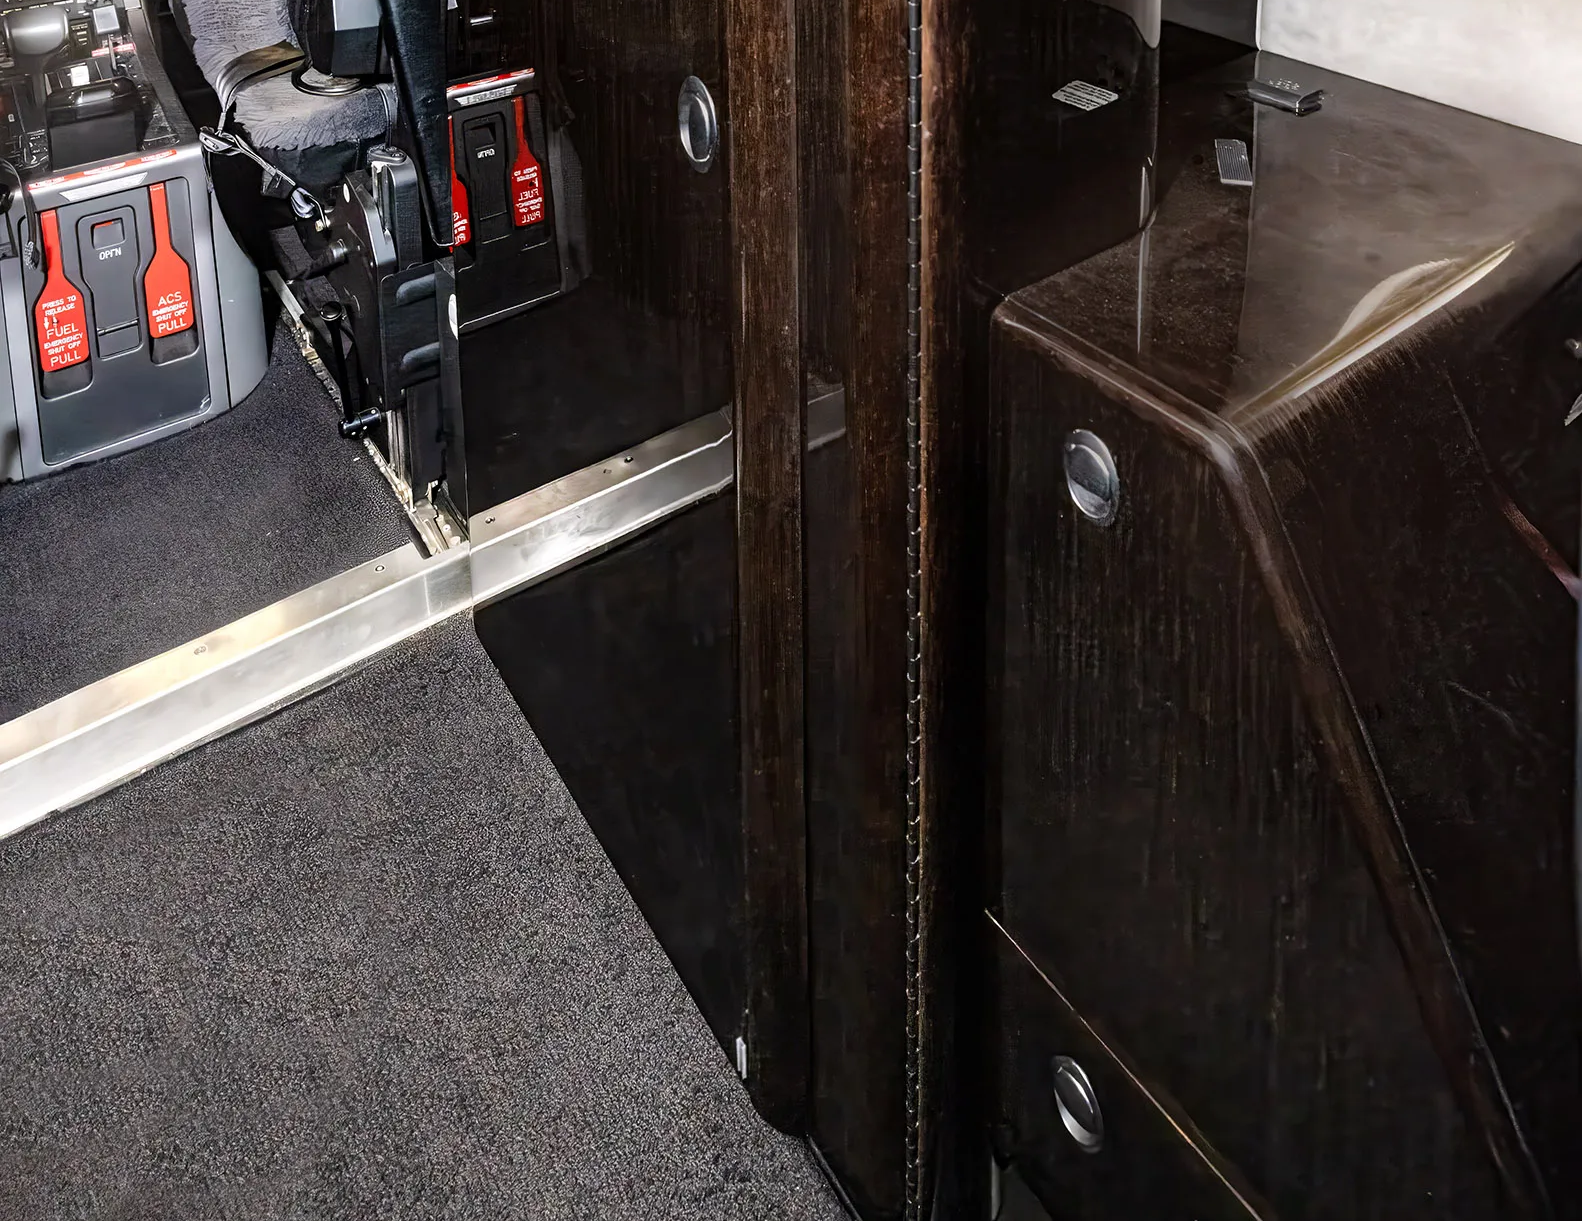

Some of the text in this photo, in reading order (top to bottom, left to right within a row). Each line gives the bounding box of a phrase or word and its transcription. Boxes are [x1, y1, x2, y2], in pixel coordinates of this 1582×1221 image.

[42, 295, 77, 310] PRESS TO
[157, 291, 182, 307] ACS
[44, 303, 76, 317] RELEASE
[151, 300, 189, 317] EMERGENCY
[155, 308, 188, 323] SHUT OFF
[46, 323, 79, 340] FUEL
[157, 317, 188, 334] PULL
[43, 332, 84, 350] EMERGENCY
[47, 341, 82, 356] SHUT OFF
[50, 350, 82, 367] PULL
